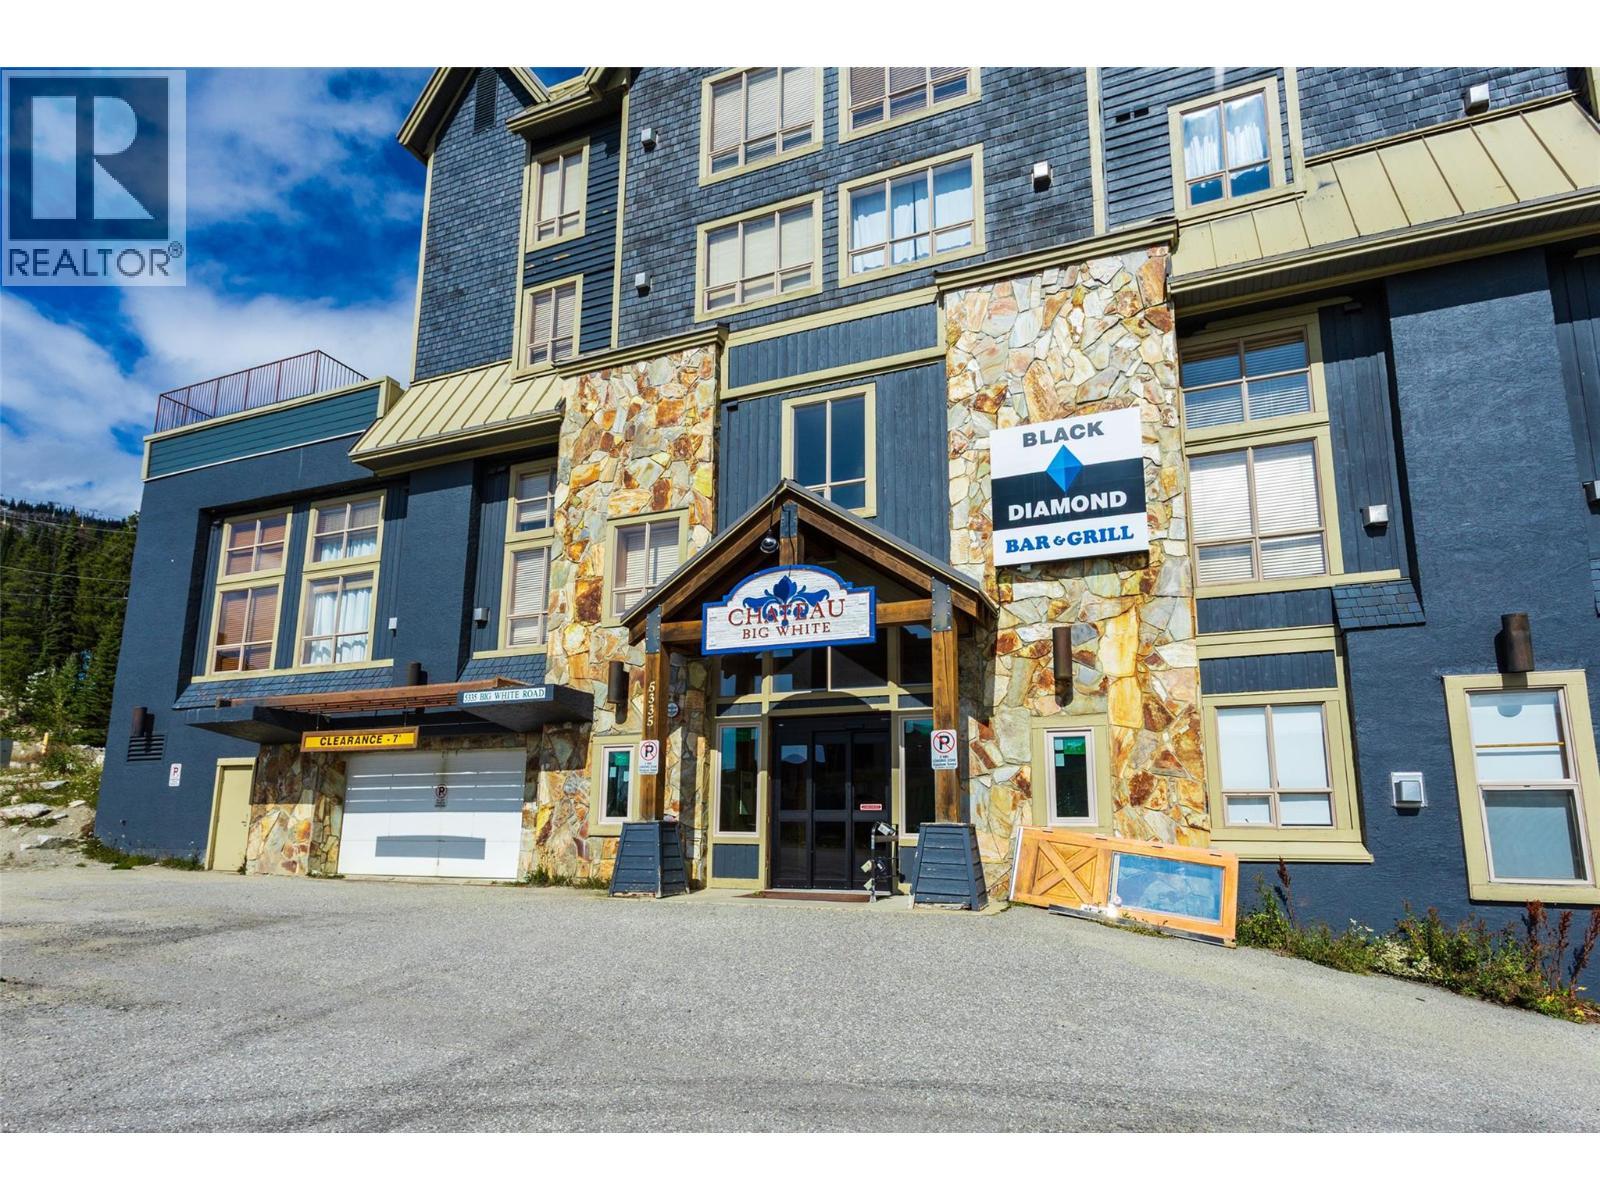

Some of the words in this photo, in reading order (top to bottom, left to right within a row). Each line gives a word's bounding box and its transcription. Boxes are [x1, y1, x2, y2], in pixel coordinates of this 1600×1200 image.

[1022, 421, 1104, 448] BLACK
[1008, 491, 1128, 521] DIAMOND
[1005, 536, 1051, 553] BAR
[1067, 526, 1134, 545] GRILL
[728, 599, 845, 626] CHATEAU
[742, 628, 769, 640] BIG
[776, 621, 831, 637] WHITE
[480, 692, 492, 701] BIG
[494, 690, 520, 700] WHITE
[522, 688, 545, 698] ROAD
[320, 735, 384, 746] CLEARANCE
